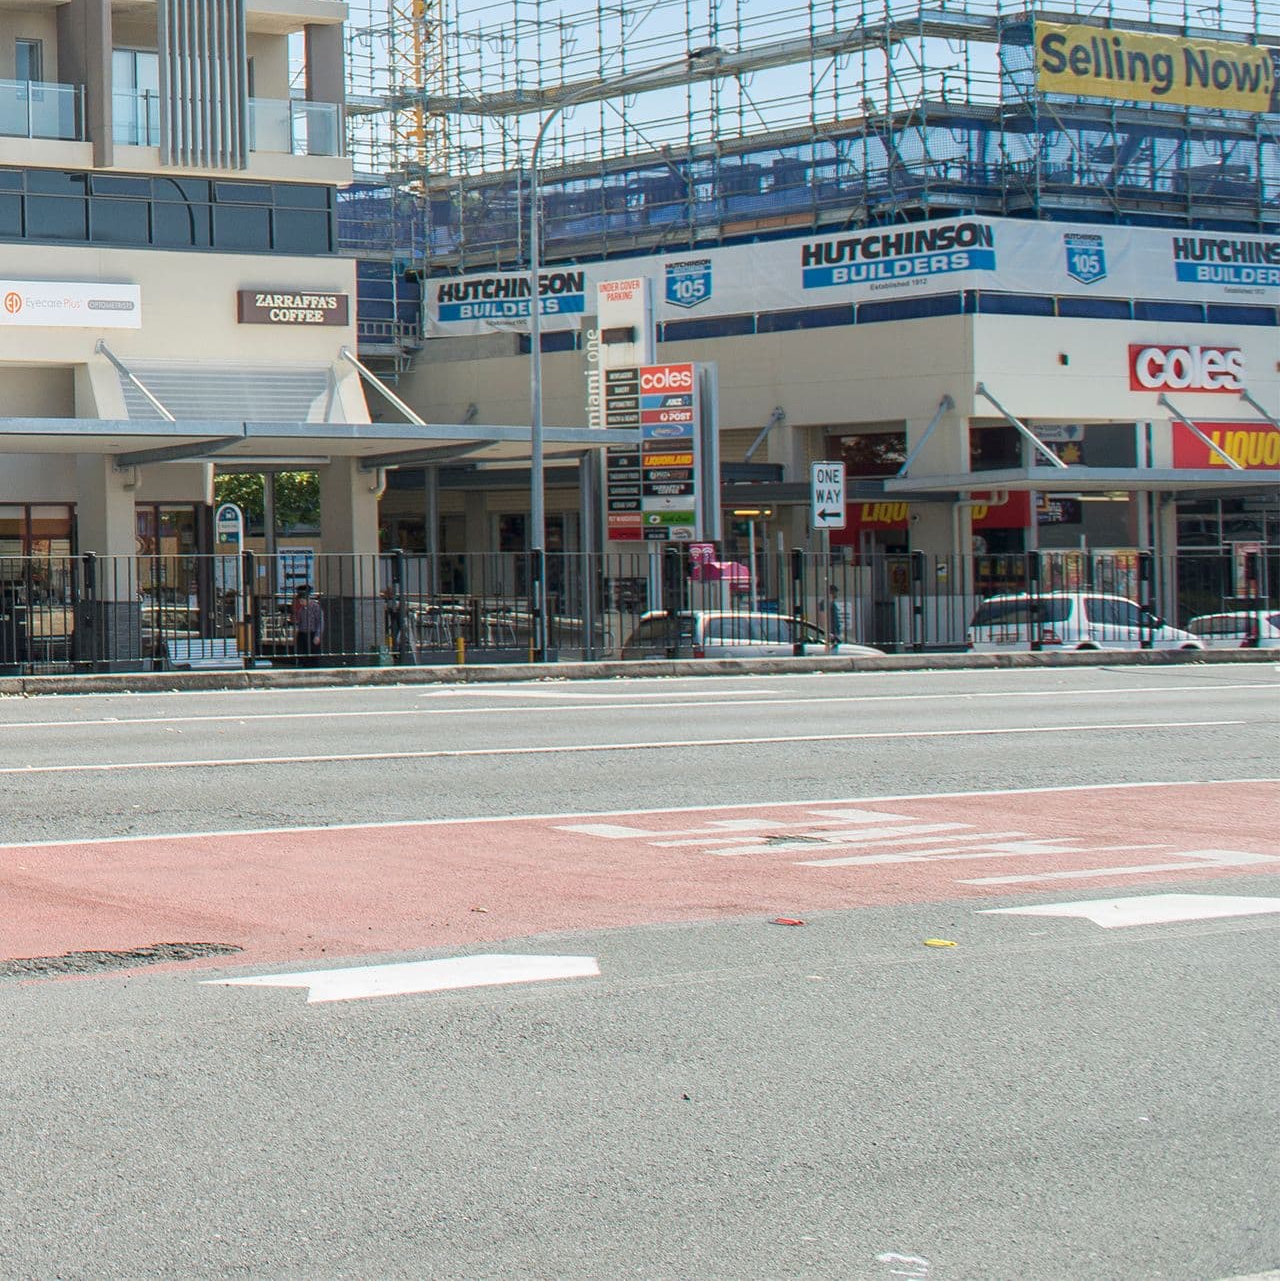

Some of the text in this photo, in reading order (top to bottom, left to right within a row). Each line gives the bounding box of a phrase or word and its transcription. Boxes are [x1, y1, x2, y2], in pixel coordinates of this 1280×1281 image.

[1041, 33, 1174, 96] Selling
[1183, 47, 1271, 95] Now!
[801, 222, 994, 267] HUTCHINSON
[831, 252, 971, 284] BUILDERS
[1072, 254, 1101, 274] 105
[437, 271, 585, 303] HUTCHINSON
[620, 279, 640, 290] COVER
[672, 279, 705, 299] 105
[255, 294, 338, 309] ZARRAFFA'S
[606, 291, 633, 302] PARKING
[269, 309, 324, 322] COFFEE
[1136, 346, 1248, 390] coles
[584, 329, 600, 429] miami one
[641, 368, 692, 389] coles
[669, 412, 691, 421] POST
[816, 468, 840, 484] ONE
[815, 489, 841, 504] WAY
